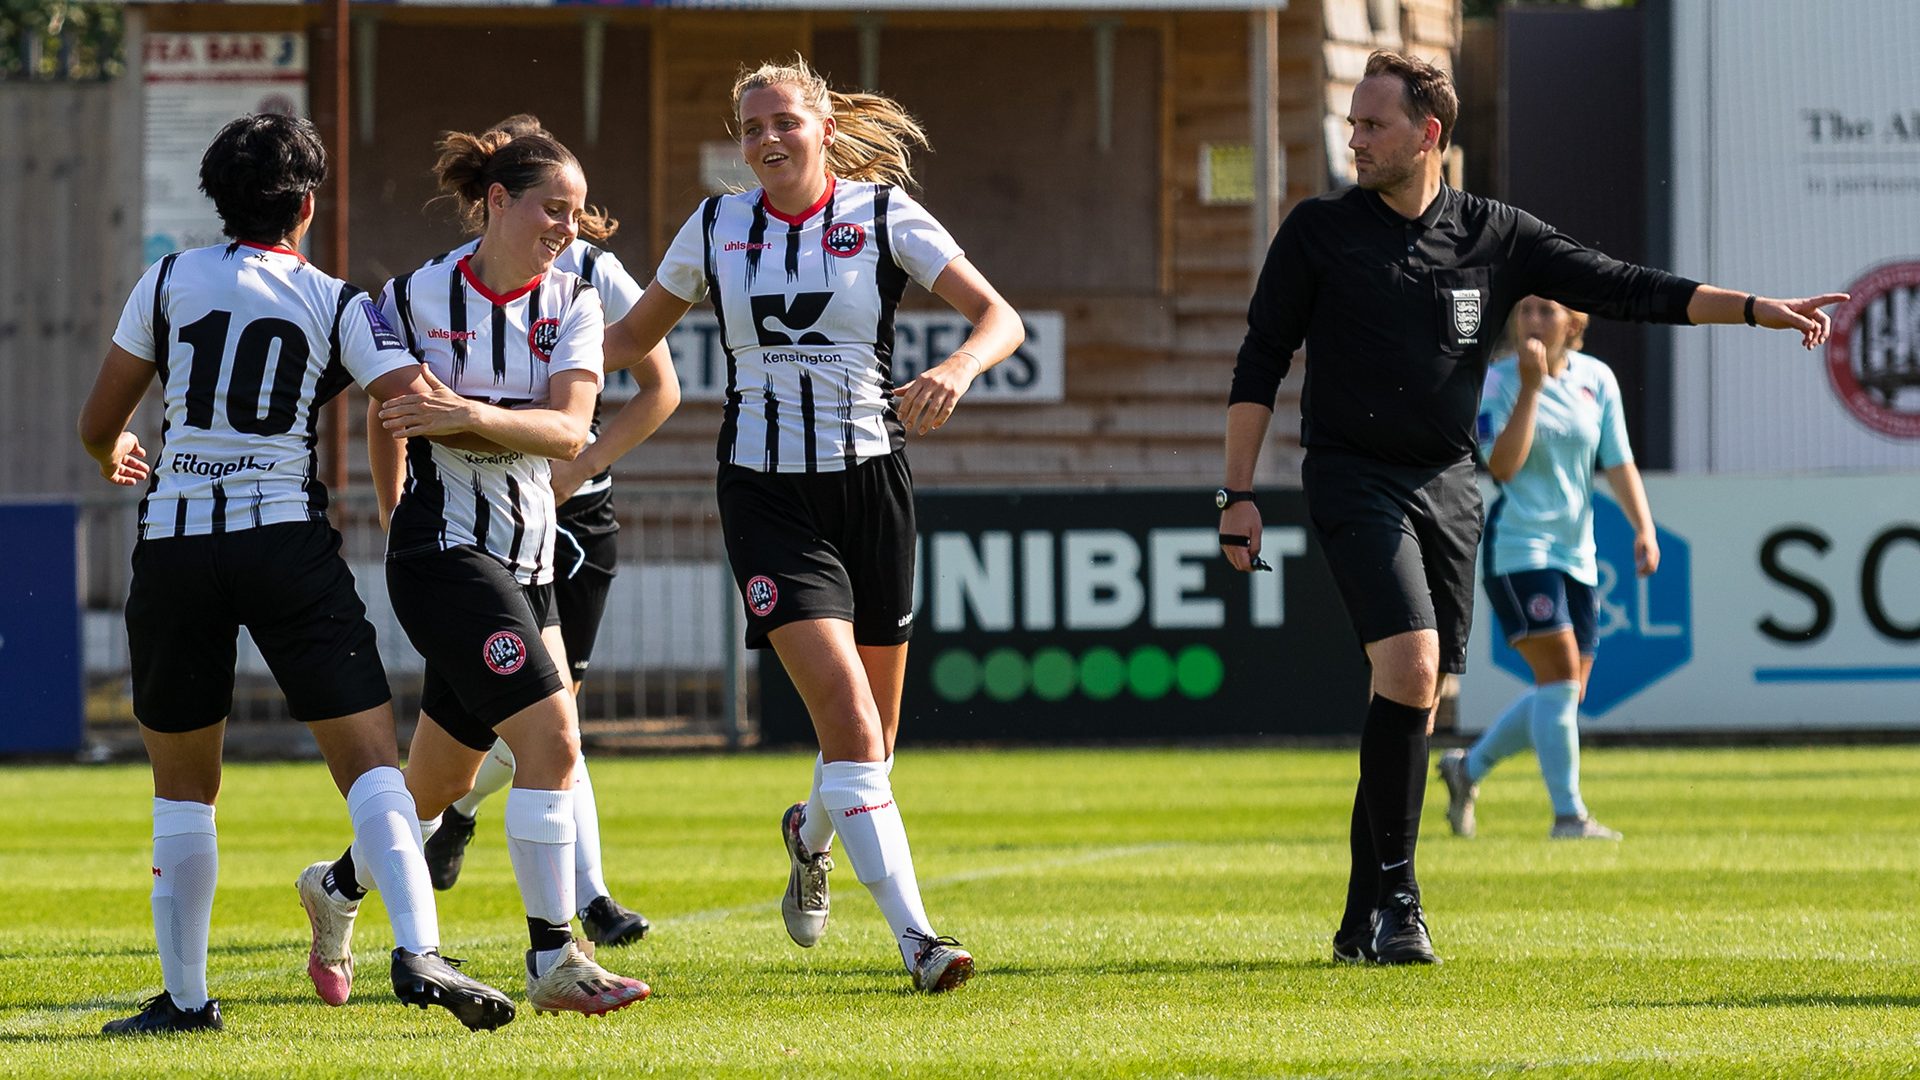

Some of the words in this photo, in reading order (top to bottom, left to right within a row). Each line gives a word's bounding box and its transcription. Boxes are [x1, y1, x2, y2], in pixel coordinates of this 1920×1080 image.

[206, 35, 266, 62] BAR
[1803, 108, 1873, 141] The
[724, 241, 772, 251] uhlsport
[428, 328, 476, 340] uhlsport
[762, 351, 842, 365] Kensington
[178, 309, 310, 437] 10
[911, 526, 1307, 632] NIBET
